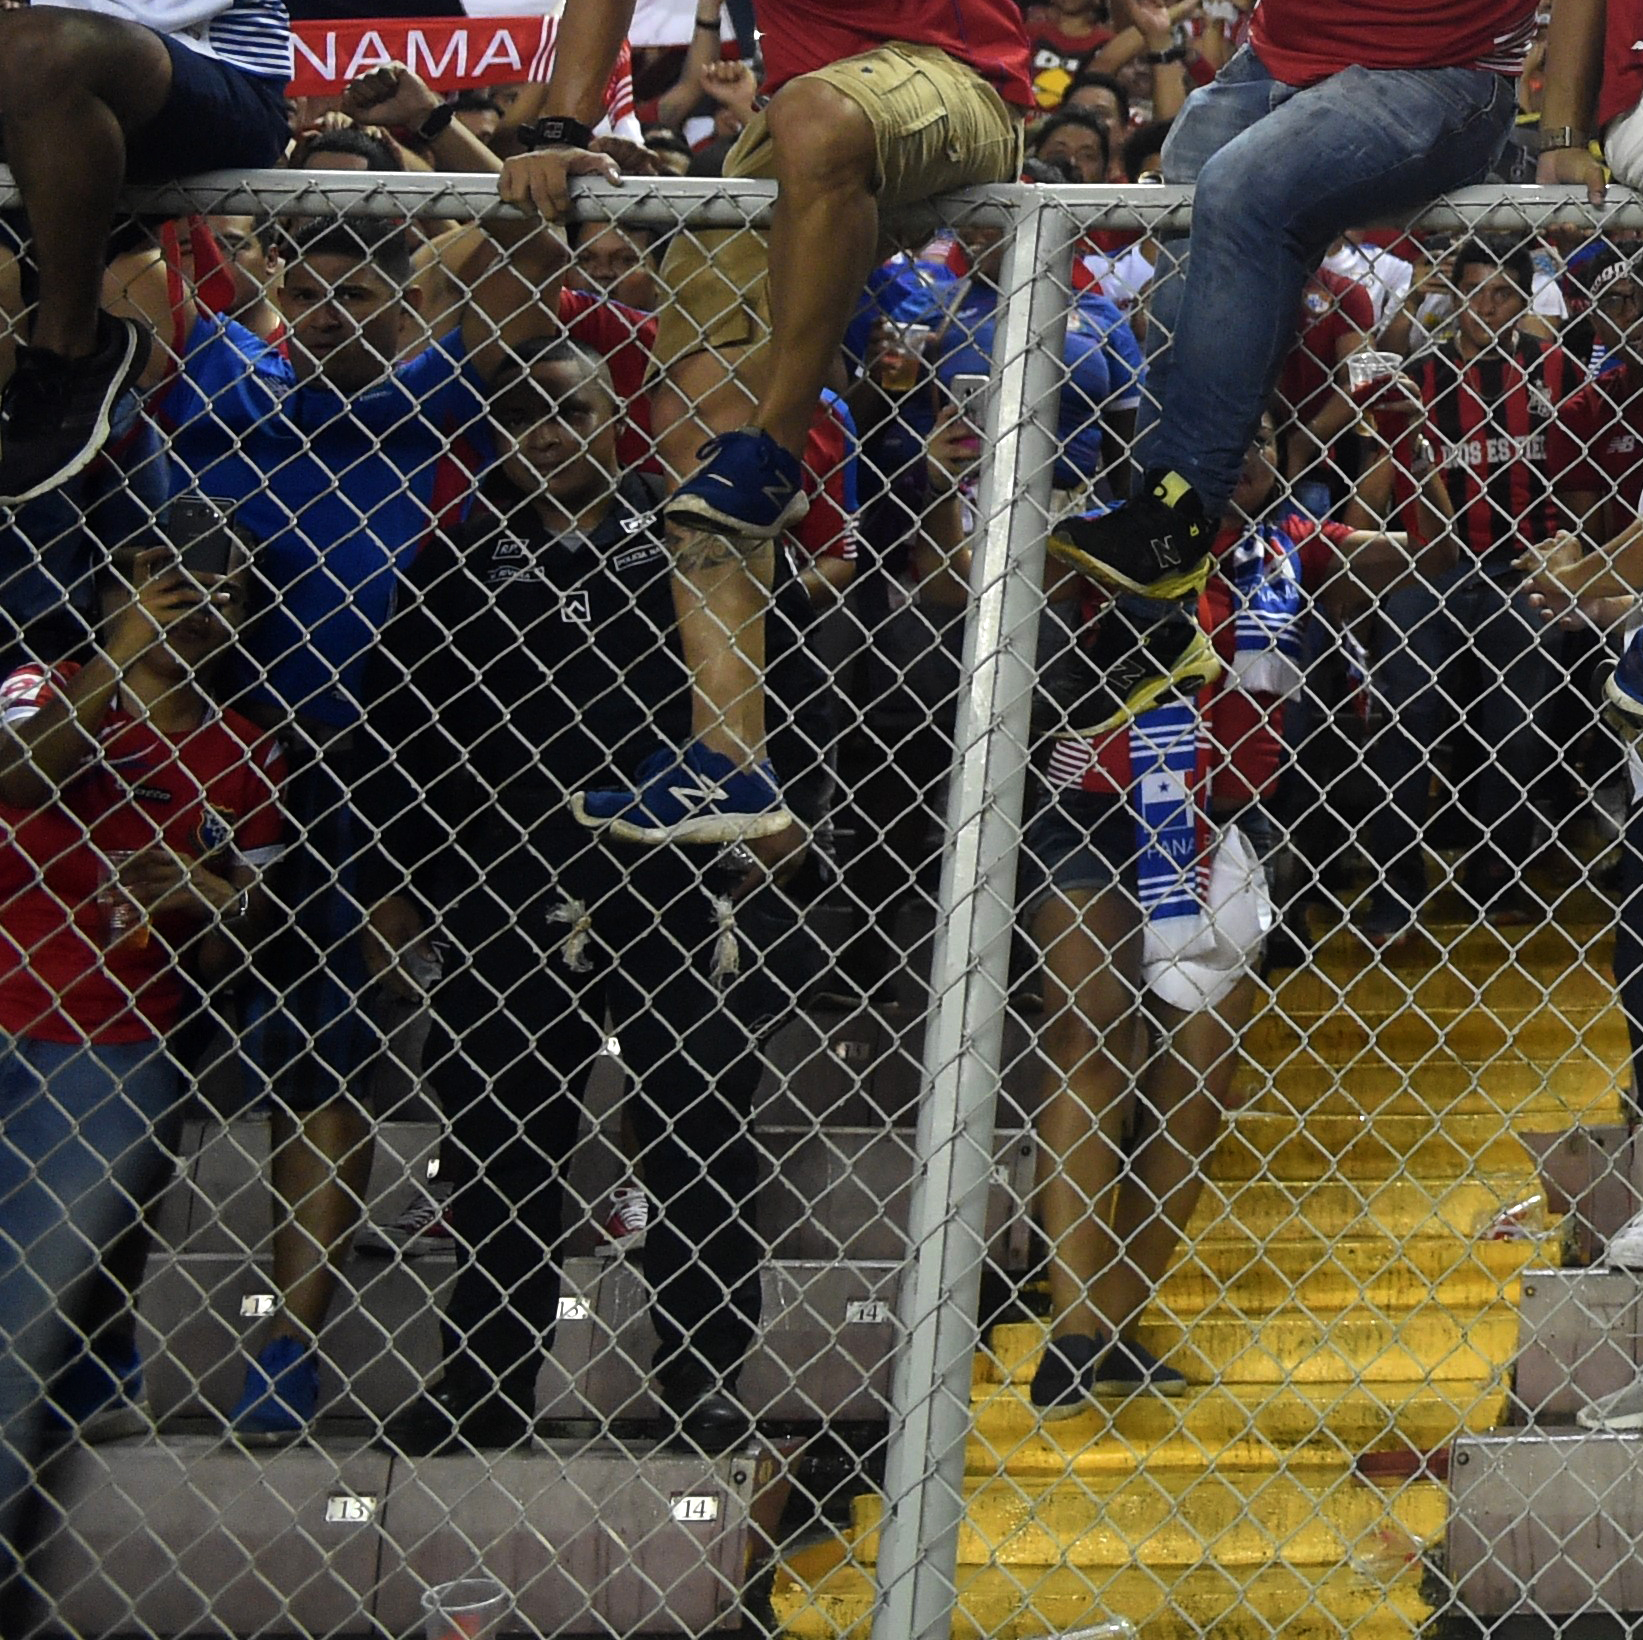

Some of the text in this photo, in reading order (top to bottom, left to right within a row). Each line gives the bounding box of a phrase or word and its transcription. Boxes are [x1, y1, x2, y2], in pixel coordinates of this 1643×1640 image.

[1486, 437, 1514, 463] ES
[343, 1500, 365, 1521] 13
[685, 1499, 707, 1520] 14
